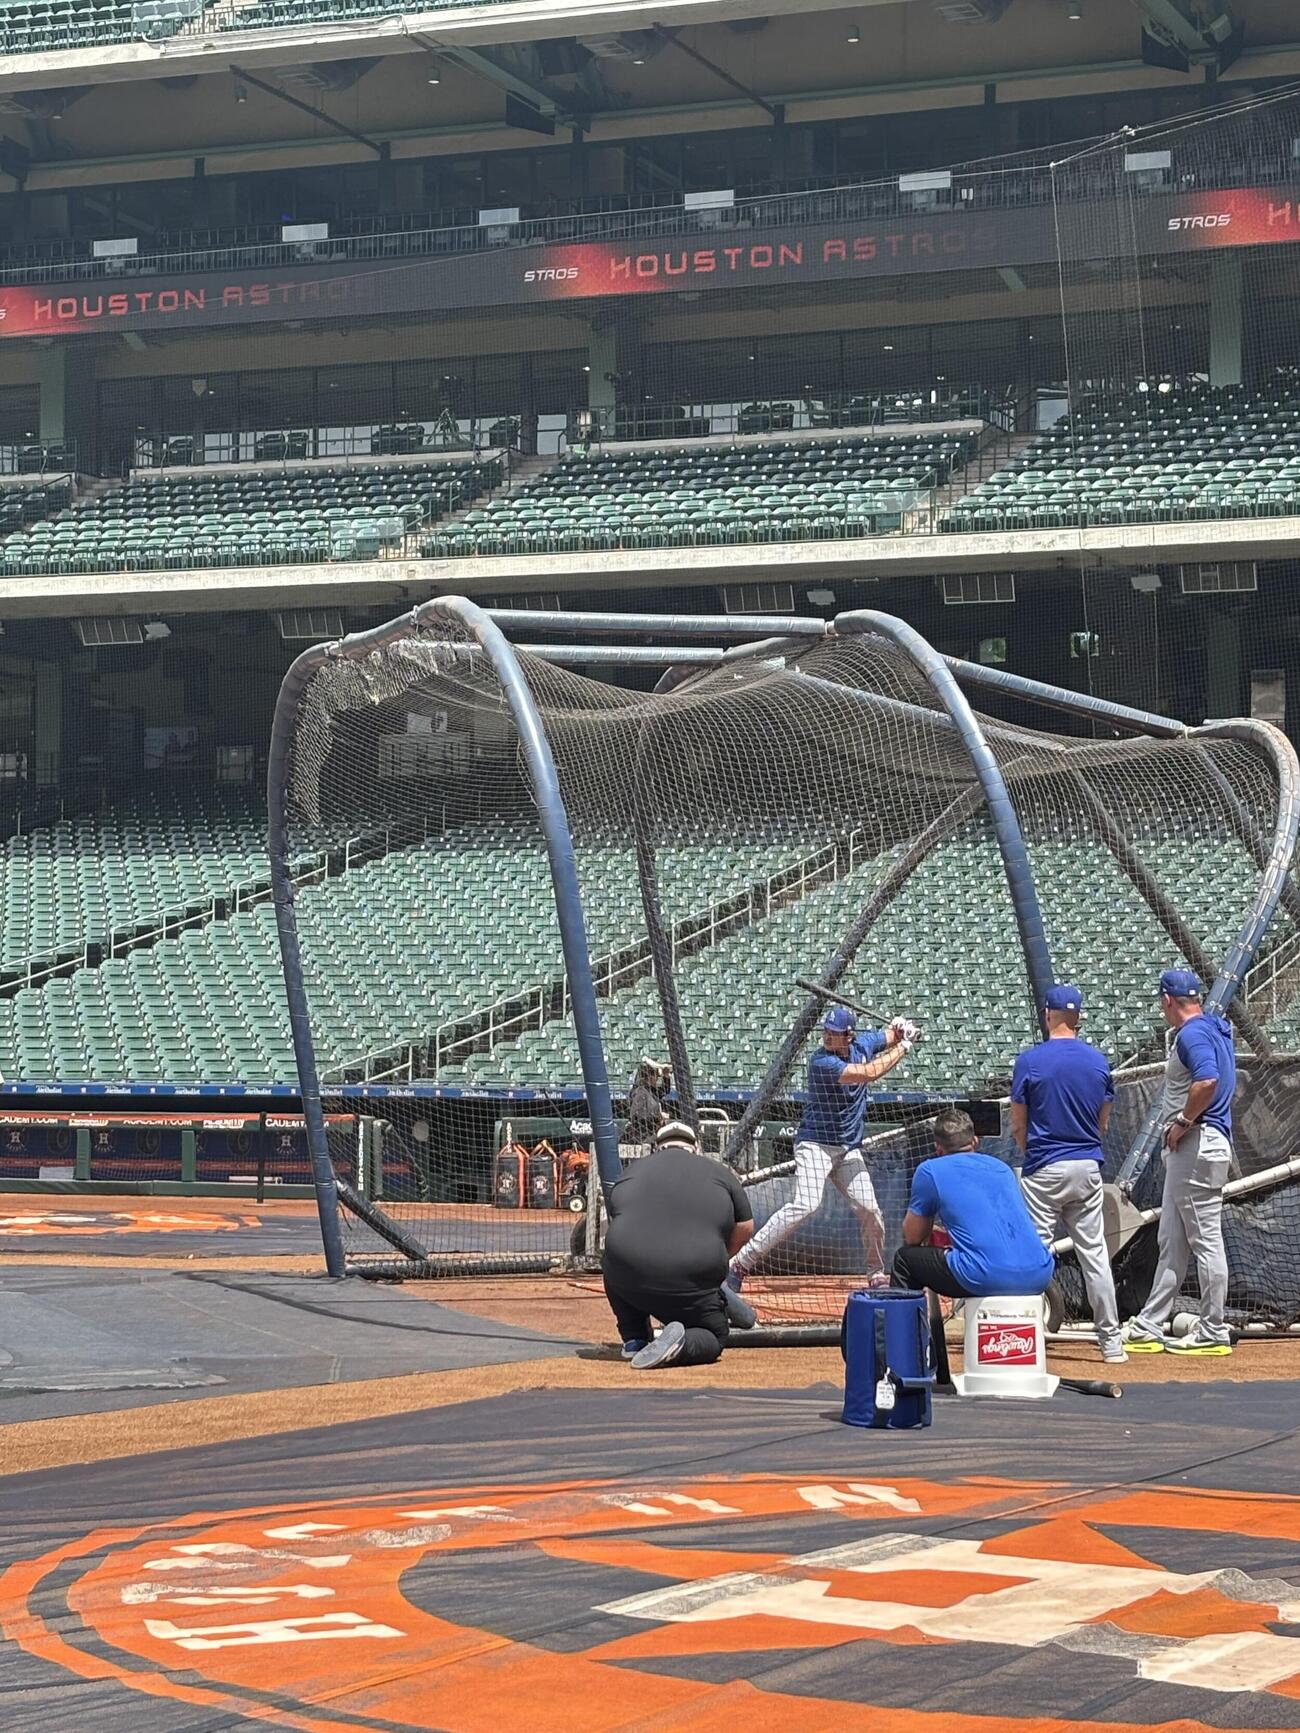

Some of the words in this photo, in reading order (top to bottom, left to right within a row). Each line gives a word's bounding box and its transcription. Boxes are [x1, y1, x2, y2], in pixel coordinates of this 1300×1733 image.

[524, 267, 579, 282] STROS
[610, 242, 804, 279] HOUSTON
[34, 288, 206, 321] HOUSTON
[981, 1332, 1034, 1357] Rawlings
